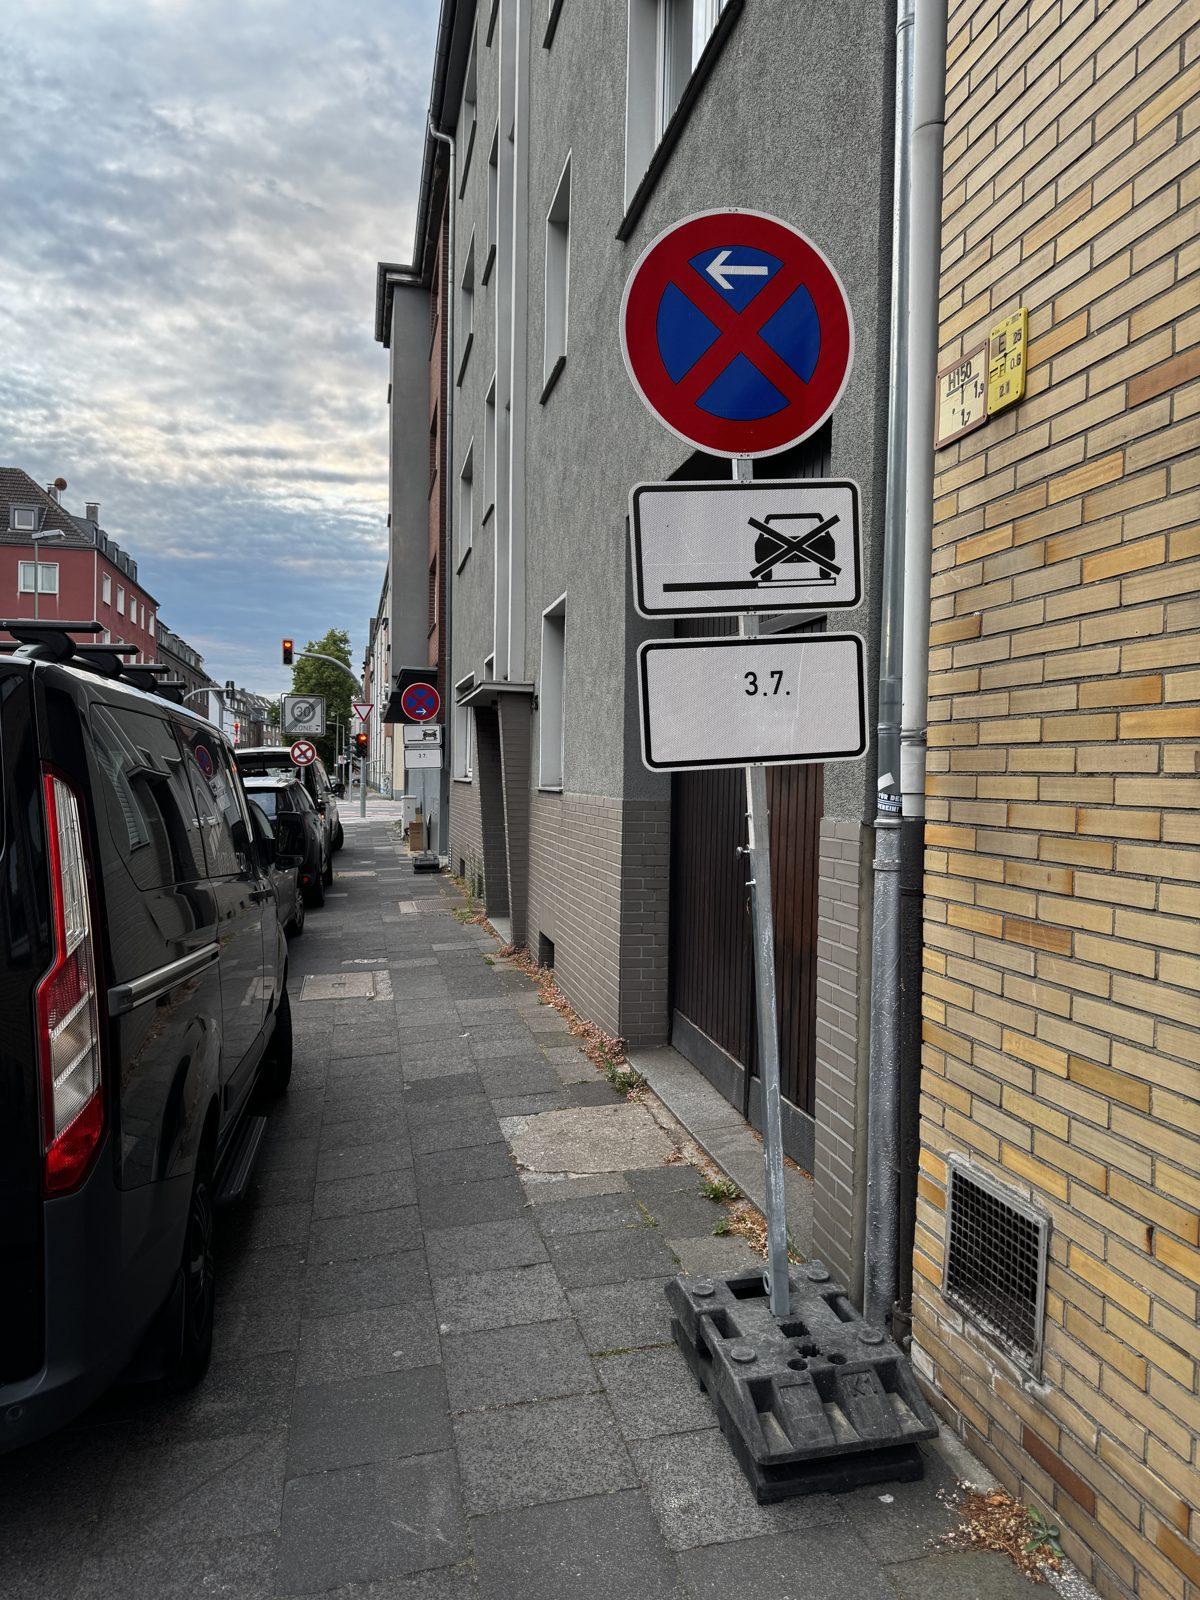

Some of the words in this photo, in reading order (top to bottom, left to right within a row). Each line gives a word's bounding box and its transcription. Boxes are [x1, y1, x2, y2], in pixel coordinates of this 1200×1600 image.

[948, 361, 971, 391] H150
[744, 670, 790, 696] 3.7.
[296, 705, 311, 718] 30
